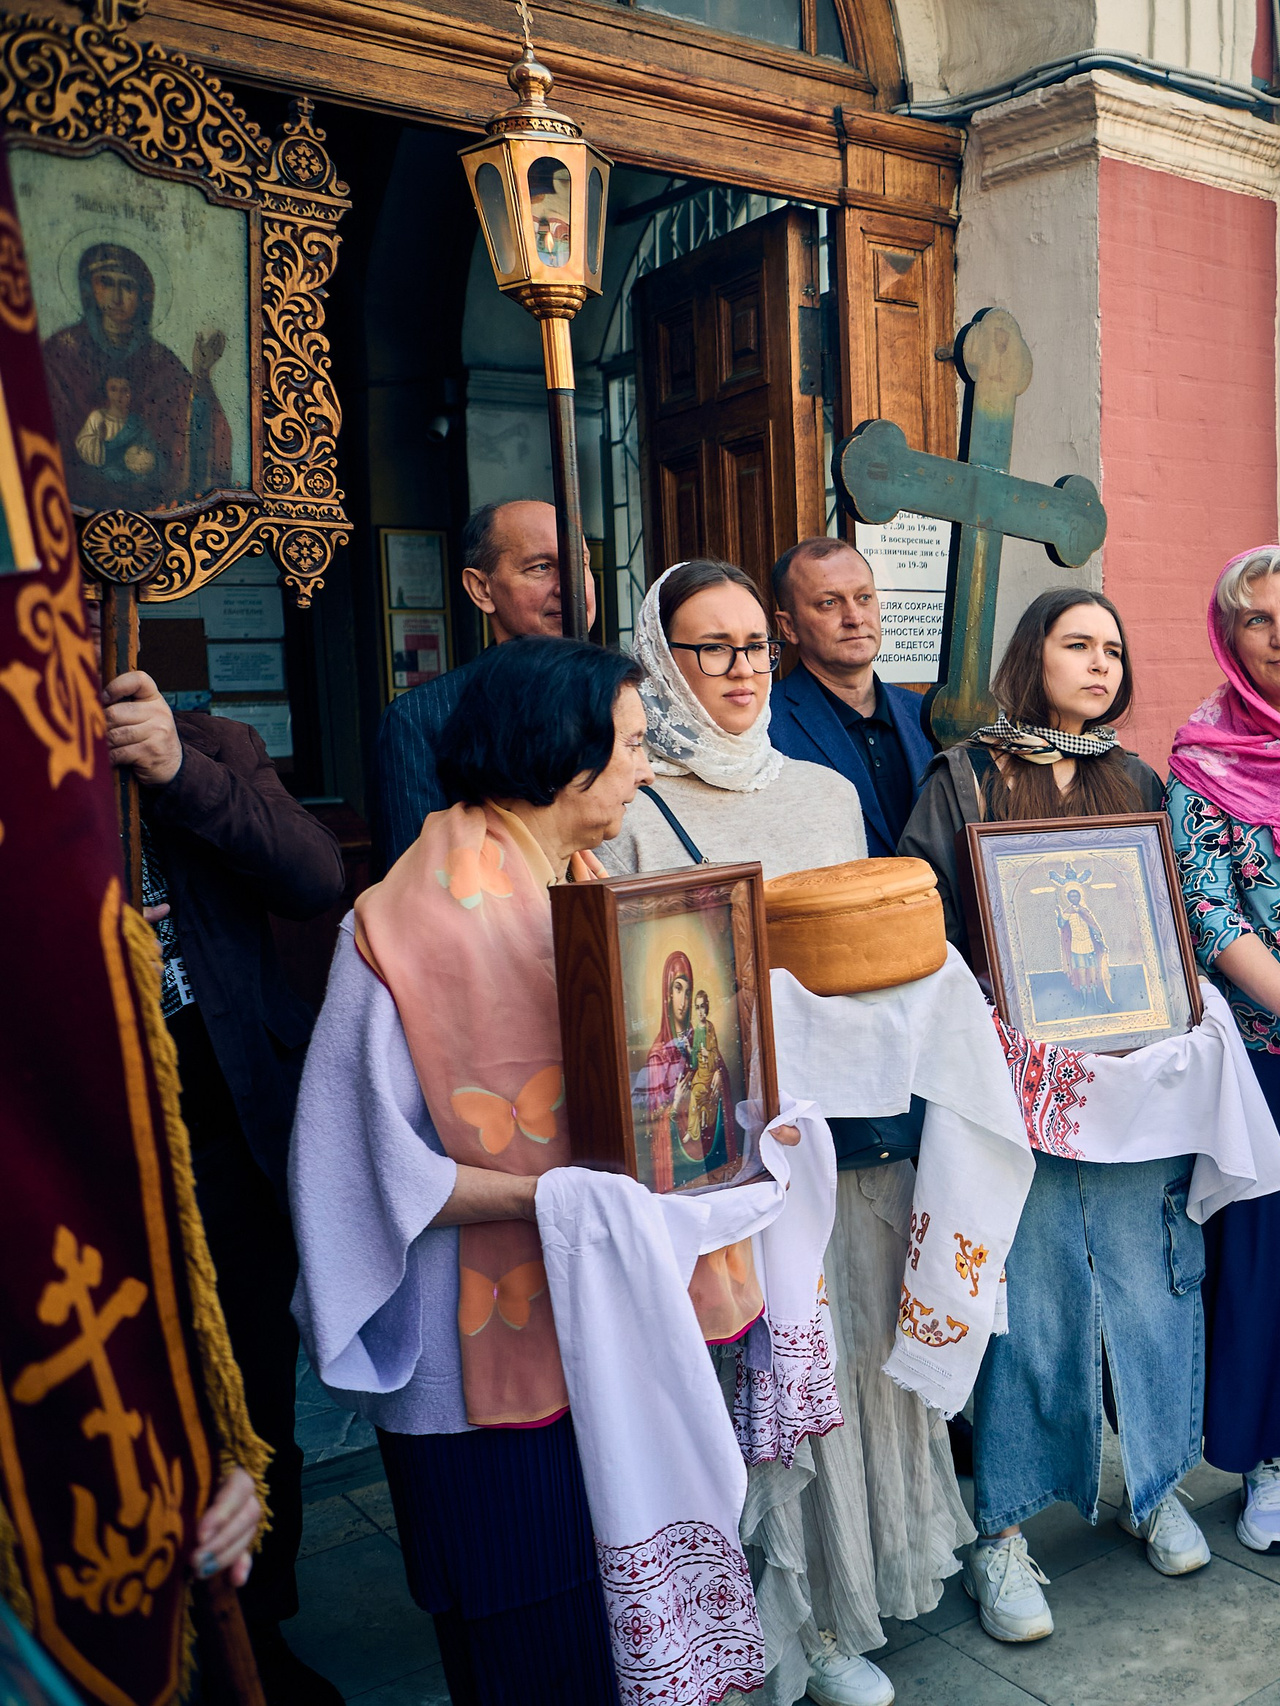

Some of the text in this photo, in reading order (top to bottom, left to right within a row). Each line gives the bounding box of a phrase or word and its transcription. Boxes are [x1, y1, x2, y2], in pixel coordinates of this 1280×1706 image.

[889, 536, 934, 545] воскресные
[863, 548, 918, 557] праздничные
[881, 601, 944, 611] ЕЛЯХ СОХРАНЕ
[881, 615, 944, 623] ИСТОРИЧЕСКИ
[880, 626, 943, 636] ЕННОСТЕЙ ХРА
[895, 641, 935, 650] ВЕДЕТСЯ
